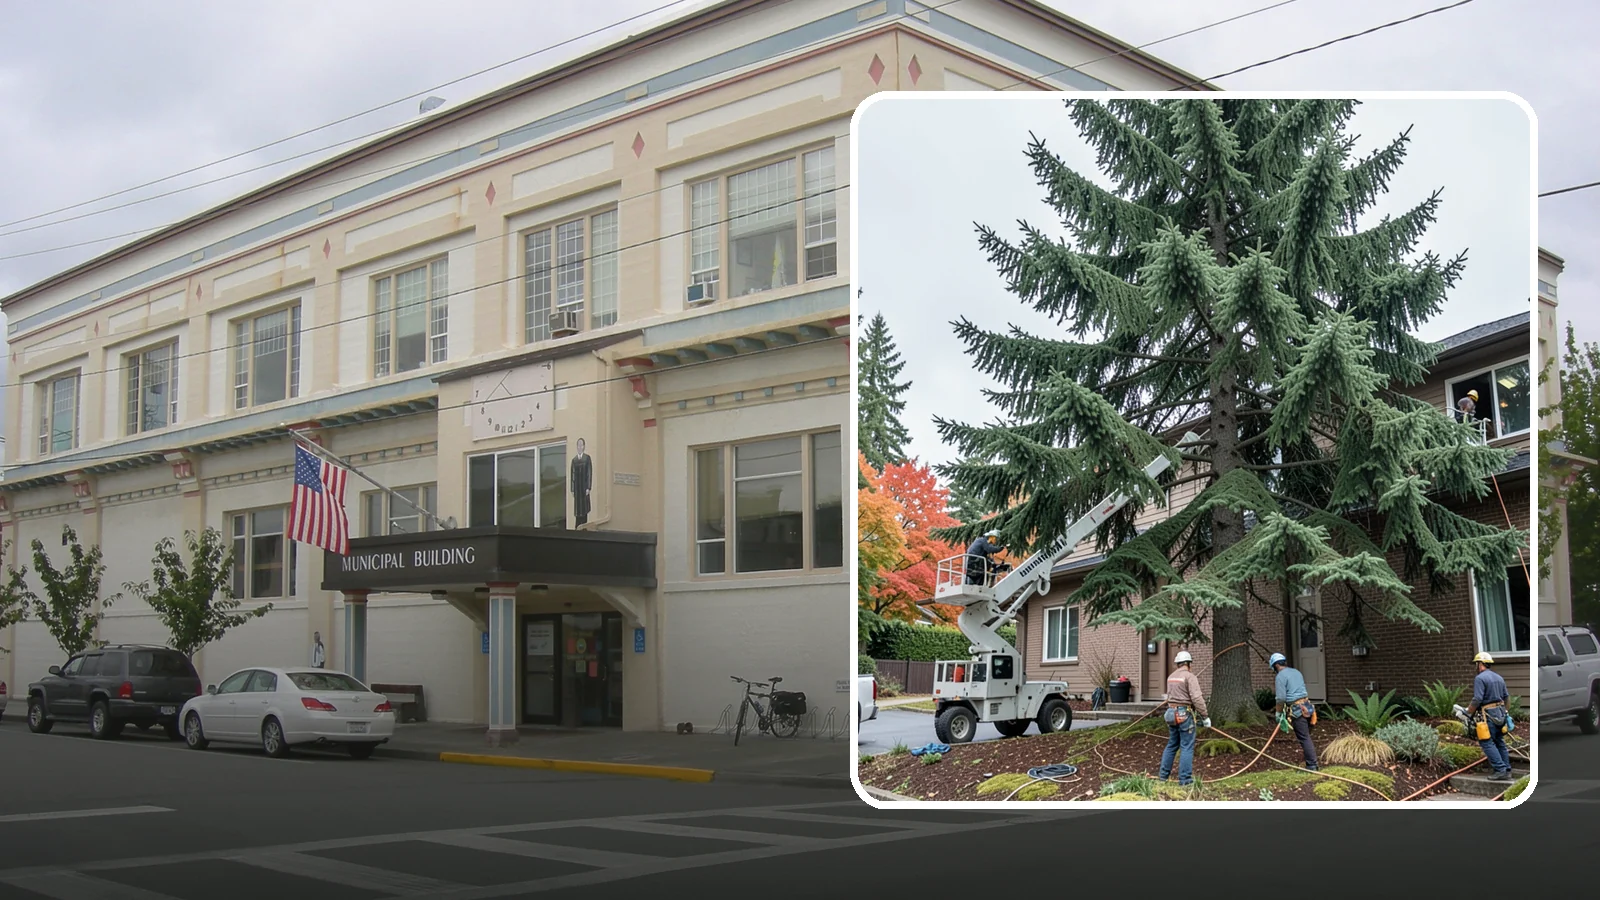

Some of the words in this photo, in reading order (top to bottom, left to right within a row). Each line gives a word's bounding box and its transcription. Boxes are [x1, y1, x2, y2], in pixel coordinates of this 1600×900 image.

[536, 402, 540, 410] 4
[480, 407, 485, 415] 8
[488, 417, 492, 426] 9
[529, 414, 533, 422] 3
[494, 423, 500, 431] 10
[507, 425, 513, 433] 12
[521, 420, 525, 428] 2
[342, 552, 405, 572] MUNICIPAL
[414, 546, 475, 567] BUILDING
